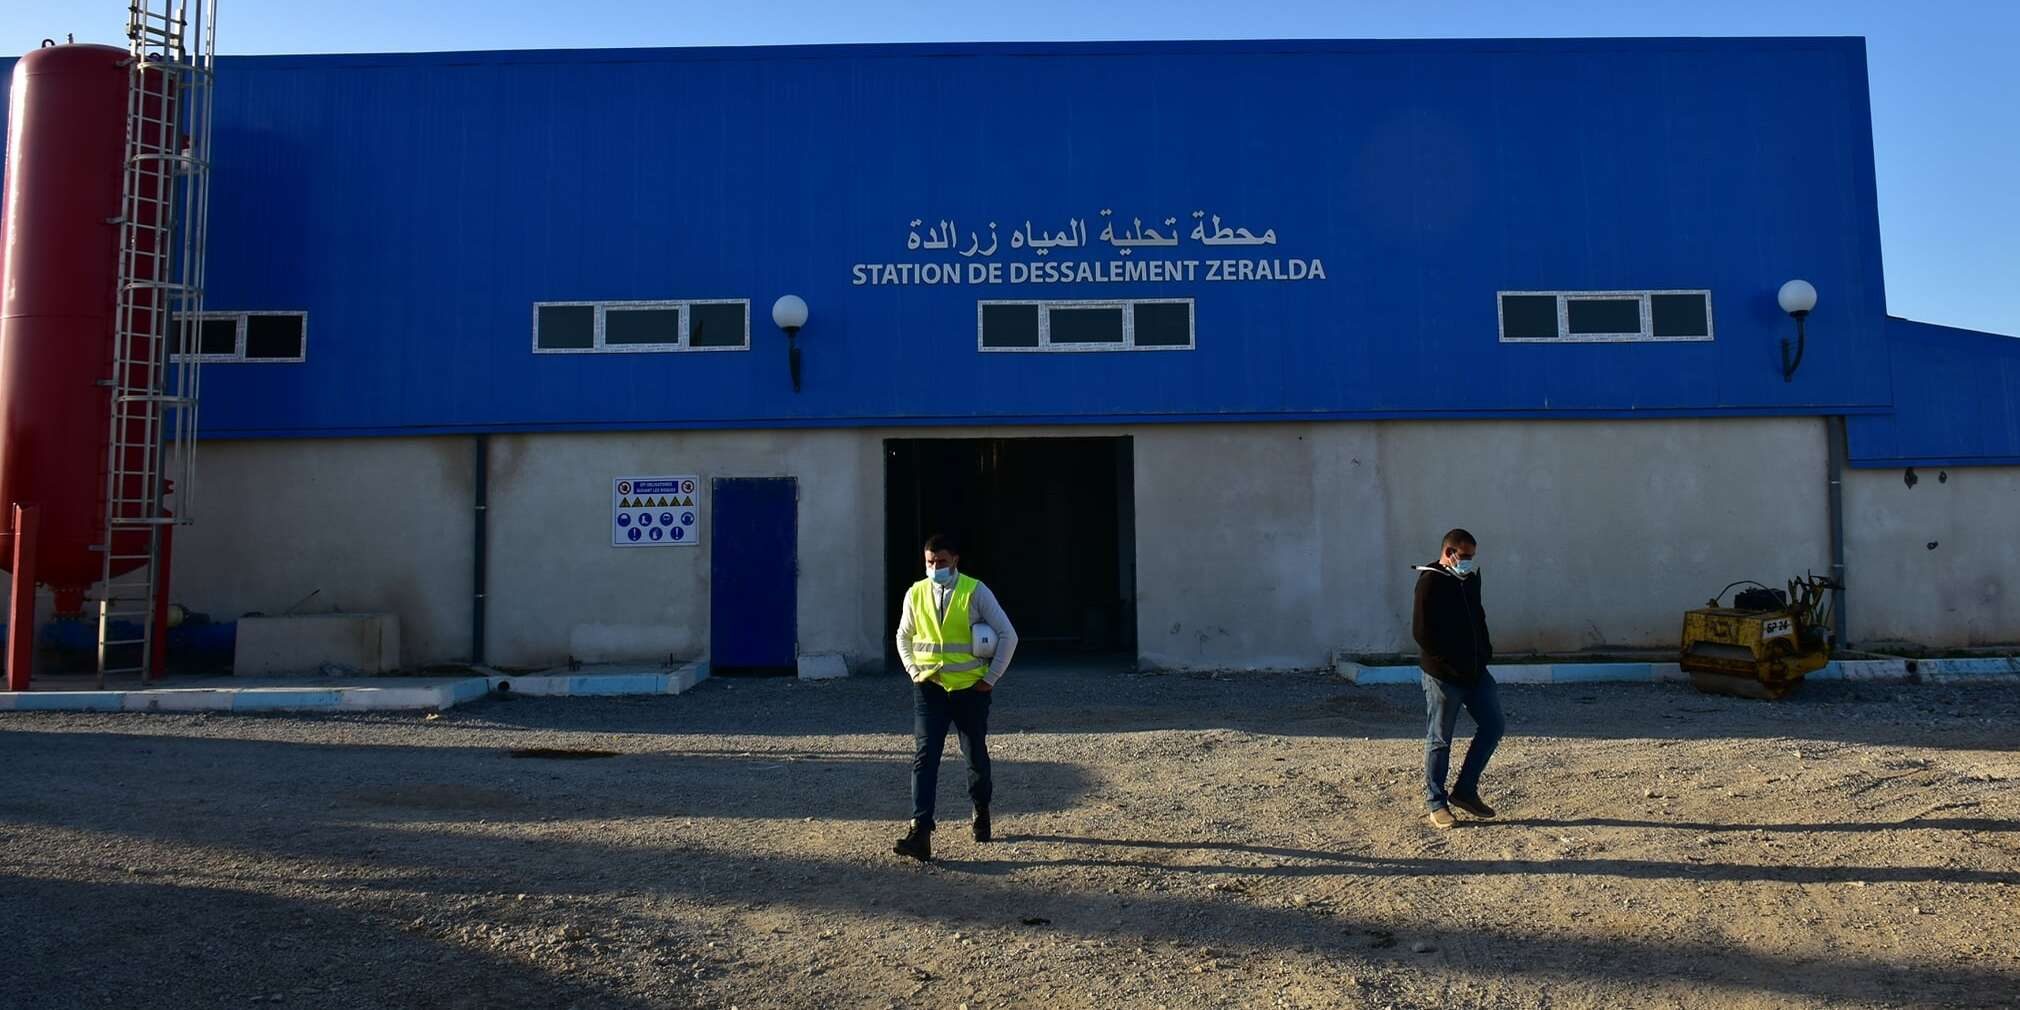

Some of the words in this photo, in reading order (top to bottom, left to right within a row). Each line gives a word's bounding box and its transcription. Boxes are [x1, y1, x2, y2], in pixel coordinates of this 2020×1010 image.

[907, 218, 998, 257] زرالدة
[1010, 216, 1087, 256] المياه
[1099, 208, 1178, 256] تحلية
[1190, 210, 1277, 247] محطة
[852, 263, 961, 285] STATION
[968, 263, 1003, 284] DE
[1010, 260, 1200, 284] DESSALEMENT
[1205, 258, 1326, 281] ZERALDA
